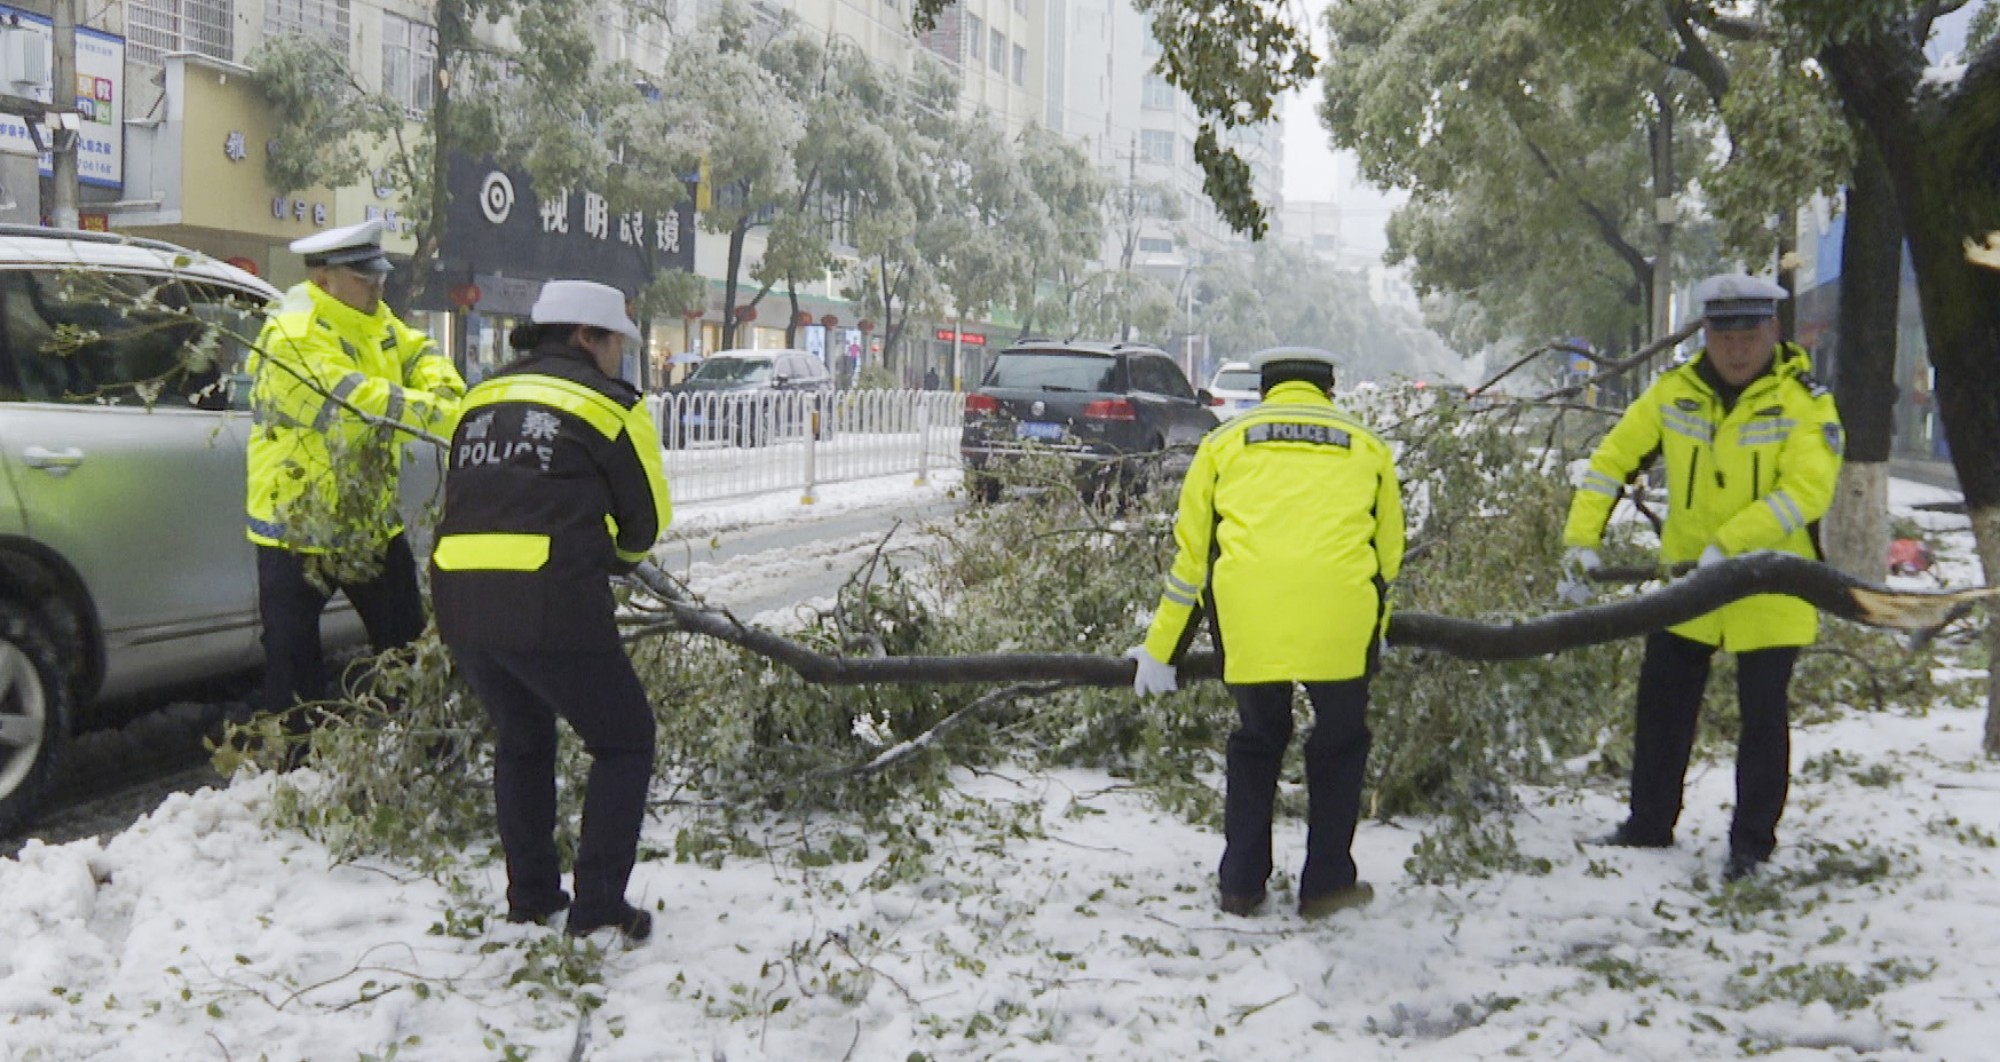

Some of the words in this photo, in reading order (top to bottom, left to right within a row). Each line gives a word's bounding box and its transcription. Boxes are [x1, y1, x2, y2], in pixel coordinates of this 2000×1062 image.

[540, 185, 680, 254] 视明眼镜
[1272, 422, 1327, 443] POLICE
